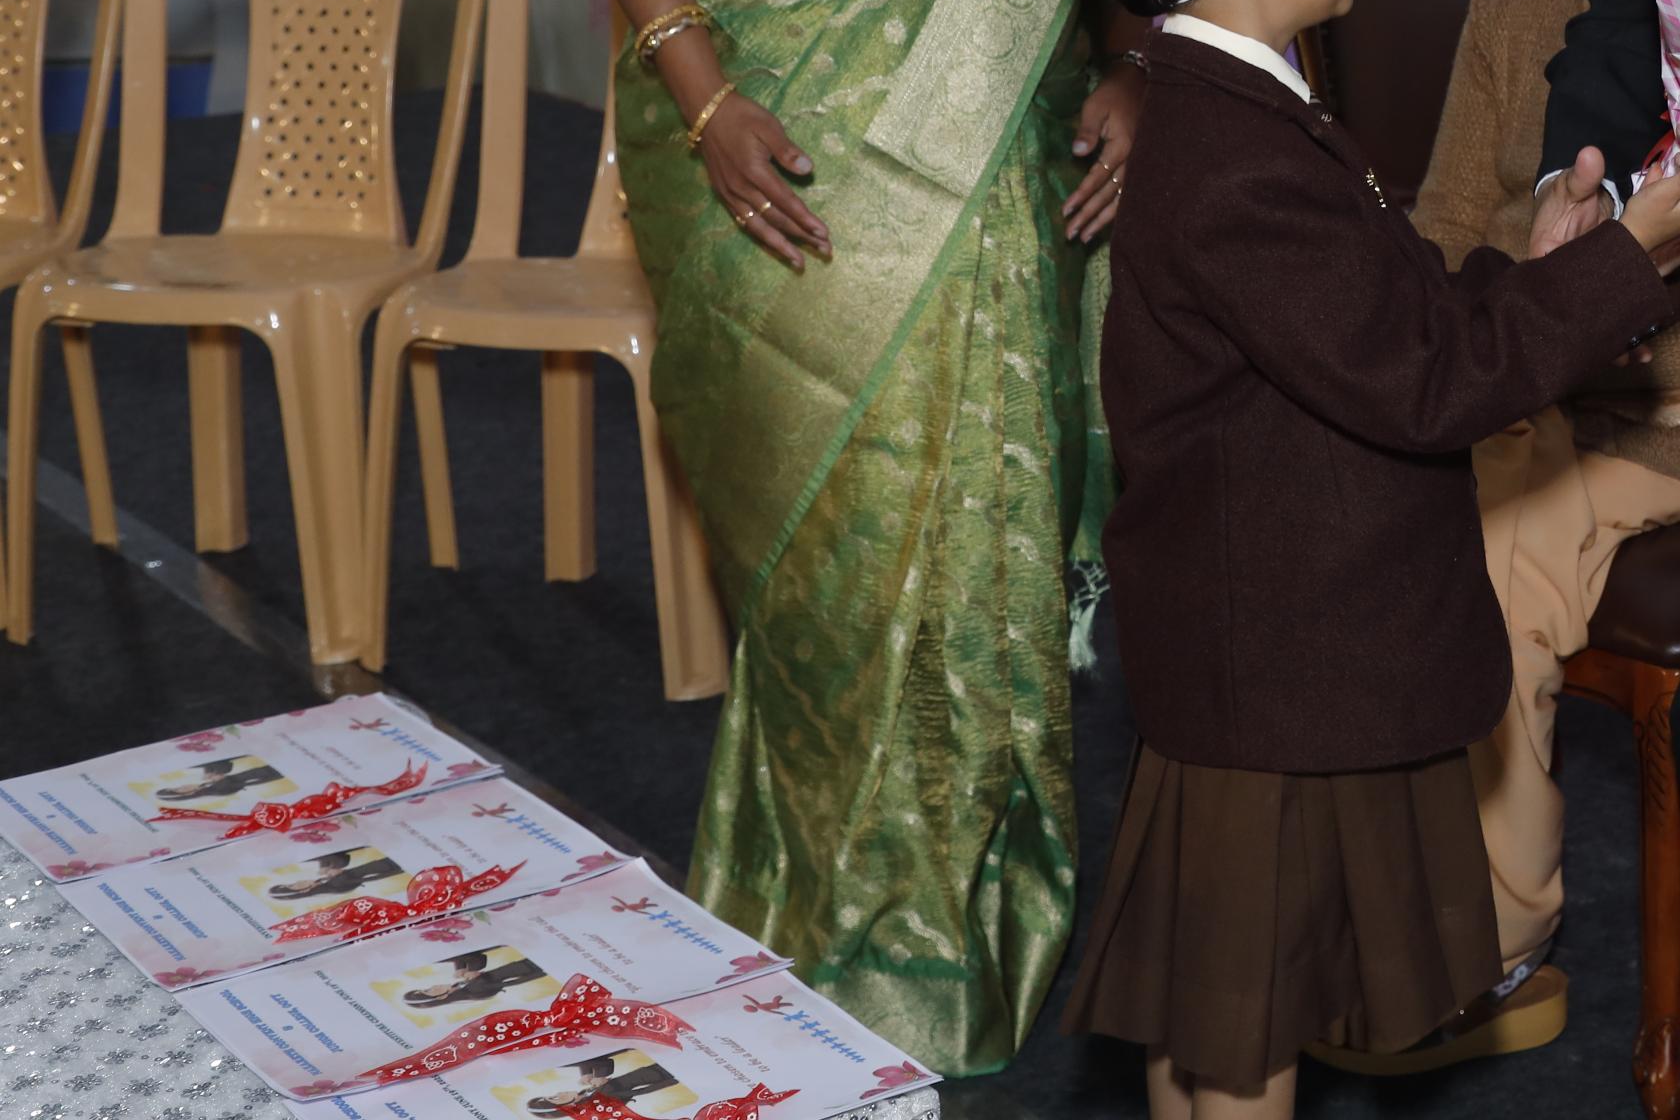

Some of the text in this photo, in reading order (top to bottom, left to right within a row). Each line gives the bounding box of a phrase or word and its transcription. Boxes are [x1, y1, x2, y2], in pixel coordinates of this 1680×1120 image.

[218, 989, 248, 1009] SCHOOL
[255, 1023, 290, 1048] CONVENT
[682, 1035, 718, 1058] embrace
[283, 1048, 321, 1075] NAZARETH
[744, 1057, 762, 1066] be
[719, 1063, 750, 1083] chosen
